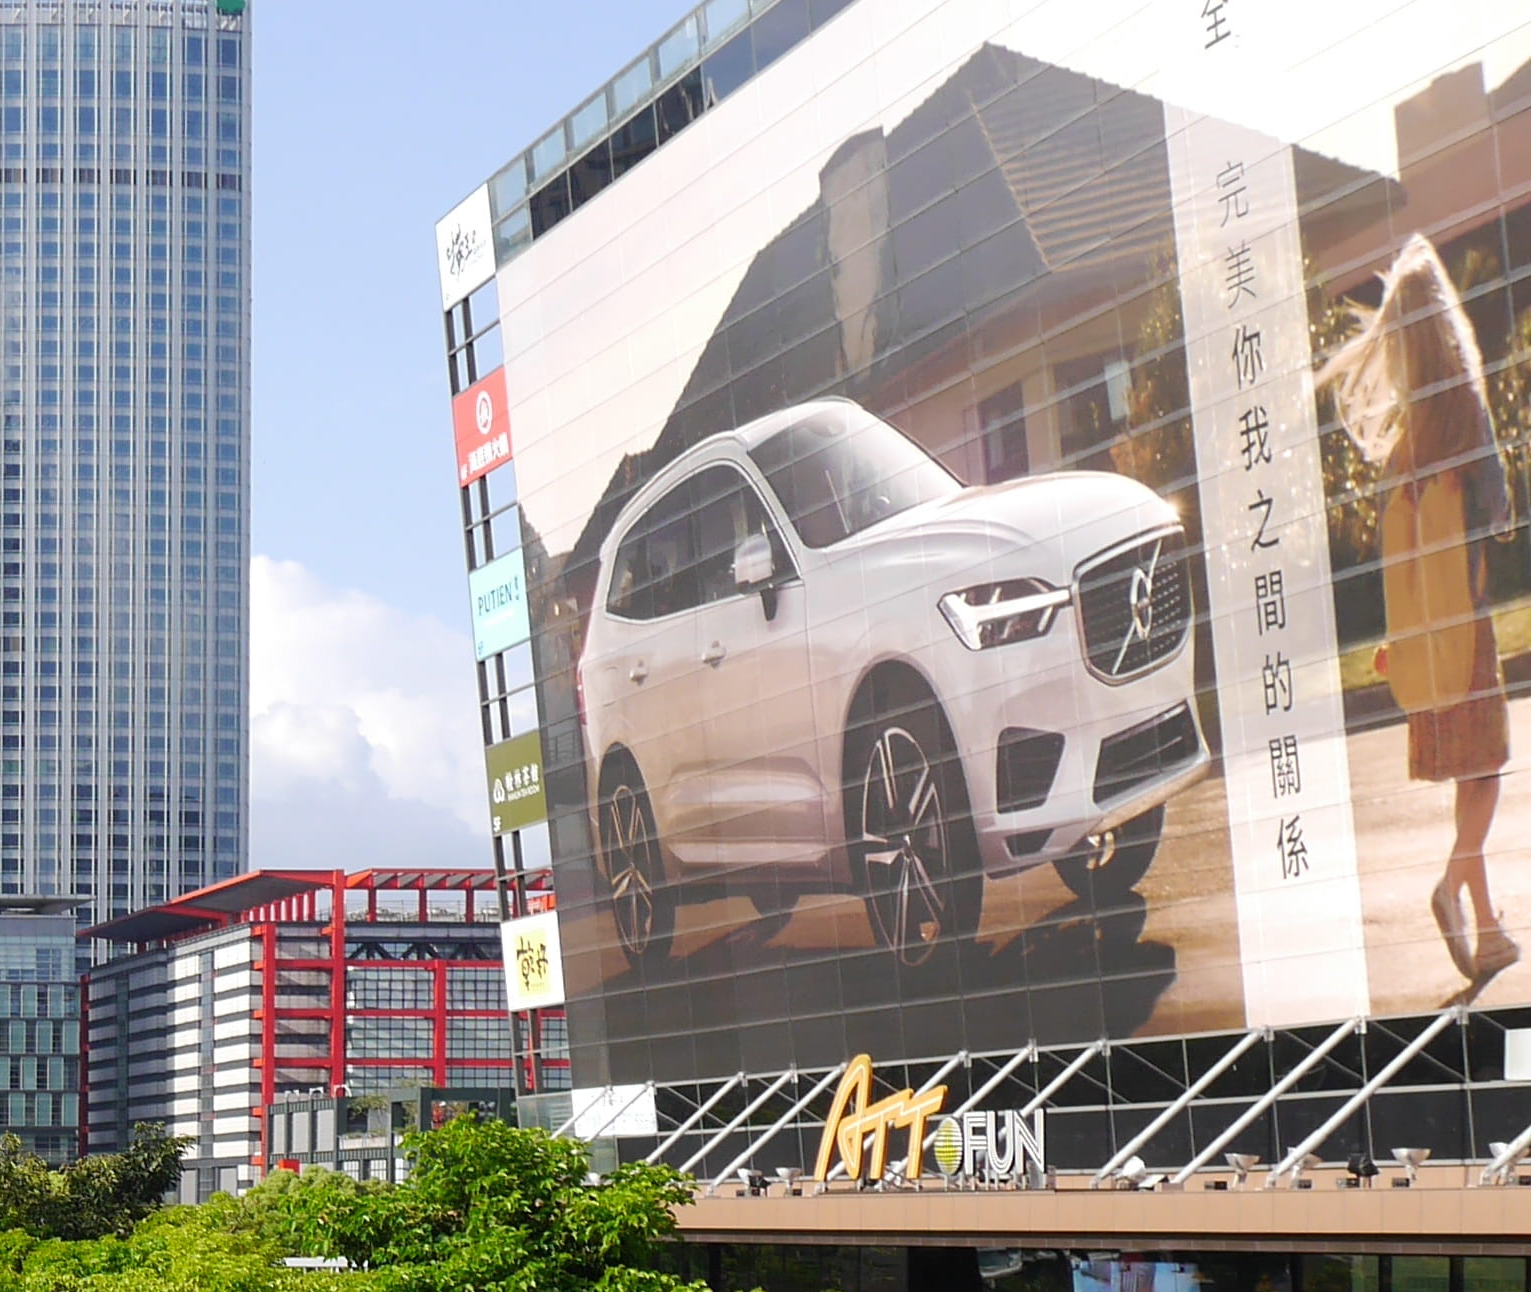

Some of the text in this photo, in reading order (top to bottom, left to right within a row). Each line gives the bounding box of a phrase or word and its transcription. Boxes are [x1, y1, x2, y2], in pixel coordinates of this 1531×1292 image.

[1216, 161, 1309, 880] 完美你我之間的關係
[478, 583, 512, 616] PUTIEN
[815, 1054, 1045, 1181] ATT FUN
